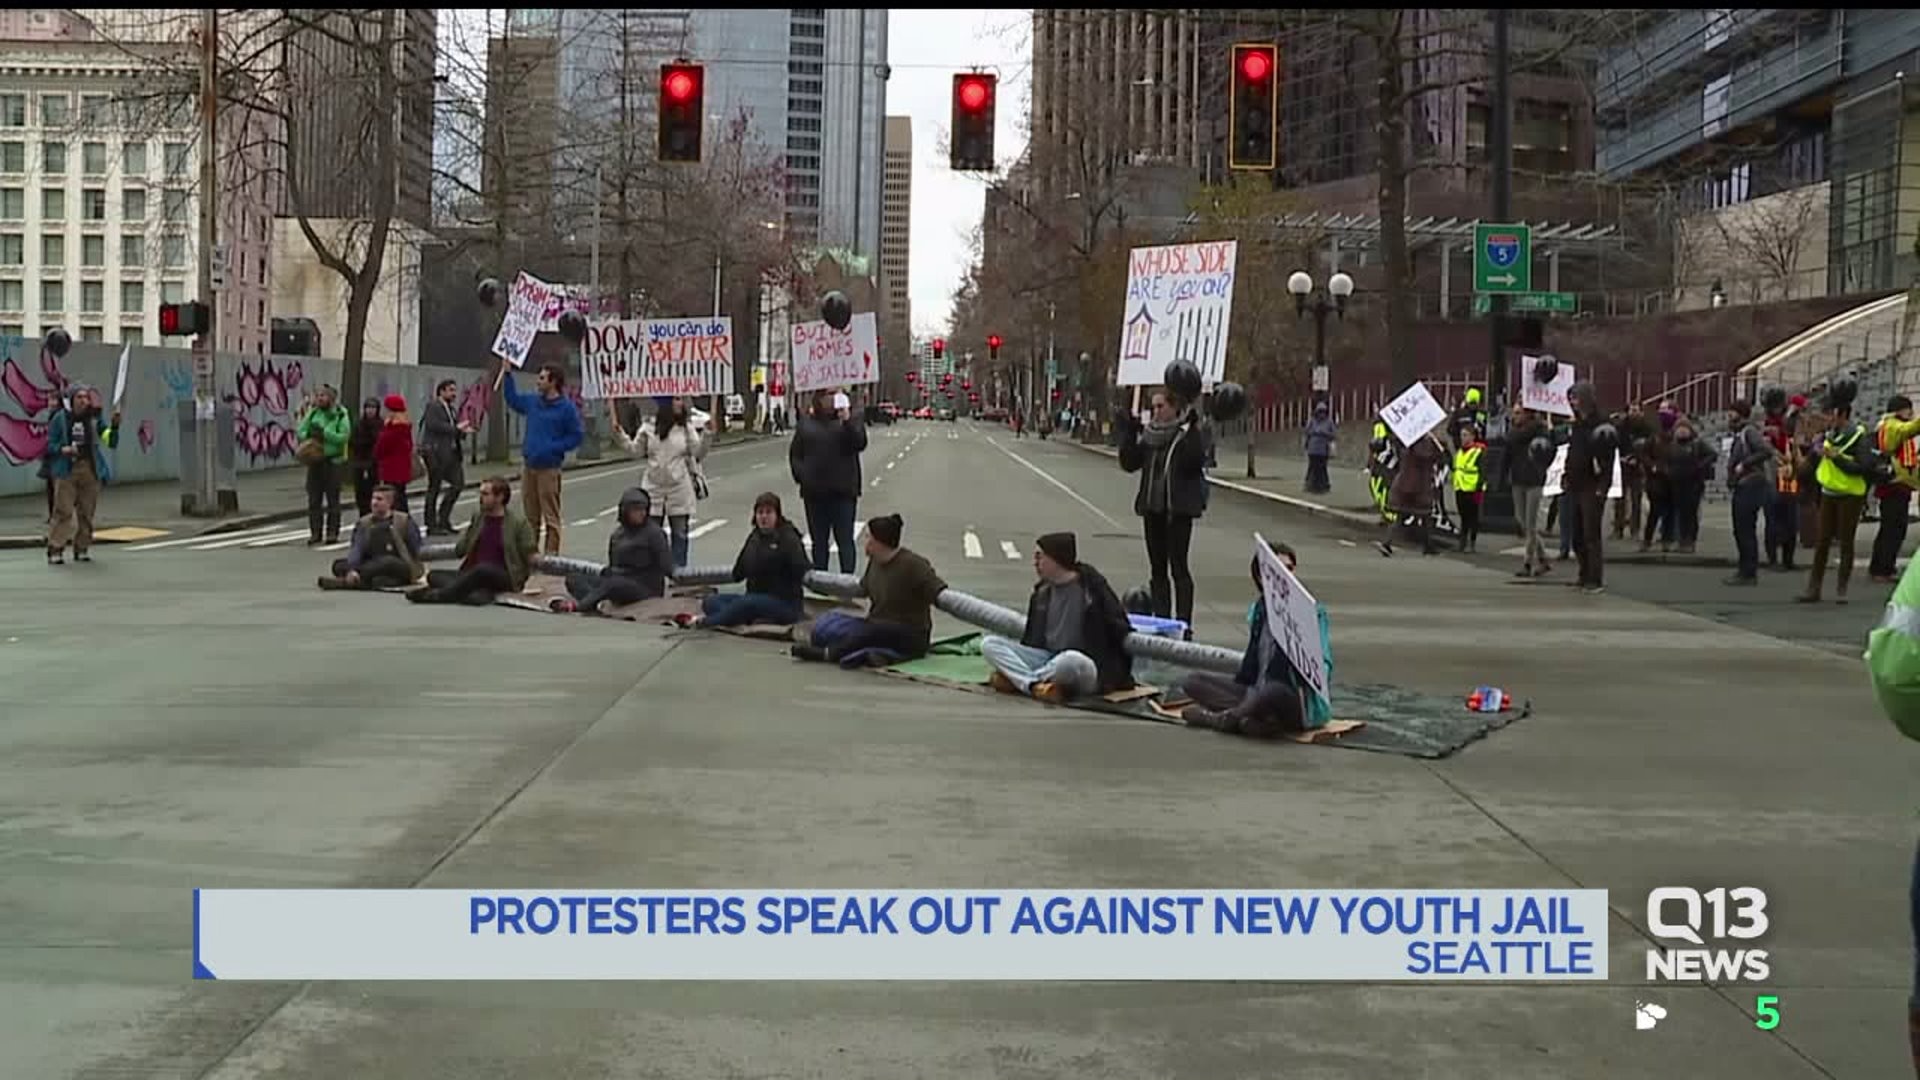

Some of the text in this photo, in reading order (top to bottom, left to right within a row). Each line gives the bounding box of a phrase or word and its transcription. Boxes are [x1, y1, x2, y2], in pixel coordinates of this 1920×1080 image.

[1131, 243, 1229, 276] WHOSE SIDE
[1498, 247, 1508, 262] 5
[1129, 276, 1162, 299] ARE
[677, 321, 703, 337] can
[706, 320, 725, 336] do
[648, 335, 732, 367] BETTER
[604, 380, 620, 396] NO
[623, 379, 645, 395] NEW
[647, 377, 679, 393] YOUTH
